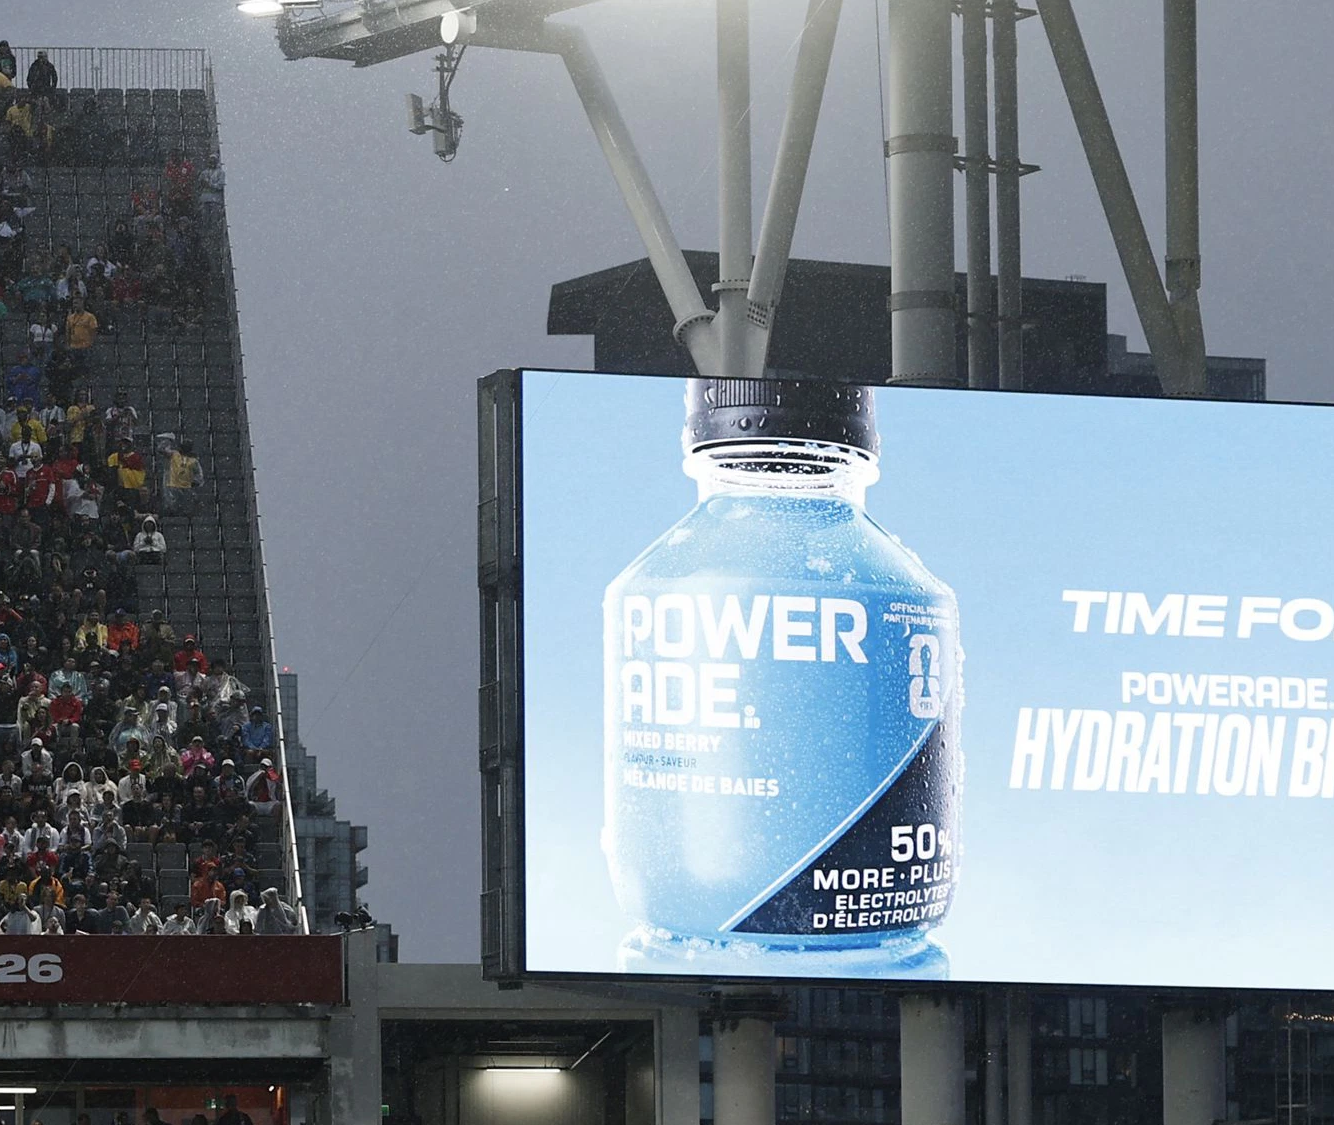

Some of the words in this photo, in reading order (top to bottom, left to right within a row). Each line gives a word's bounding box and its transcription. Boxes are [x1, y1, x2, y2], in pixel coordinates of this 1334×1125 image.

[889, 602, 925, 614] OFFICIAL
[1062, 589, 1228, 638] TIME
[622, 594, 869, 664] POWER
[622, 730, 661, 750] MIXED
[665, 732, 722, 753] BERRY
[1009, 706, 1287, 797] HYDRATION
[622, 767, 687, 791] MÉLANGE
[691, 775, 716, 794] DE
[720, 777, 779, 797] BAIES
[891, 823, 952, 862] 50%
[813, 868, 895, 890] MORE
[910, 860, 951, 885] PLUS
